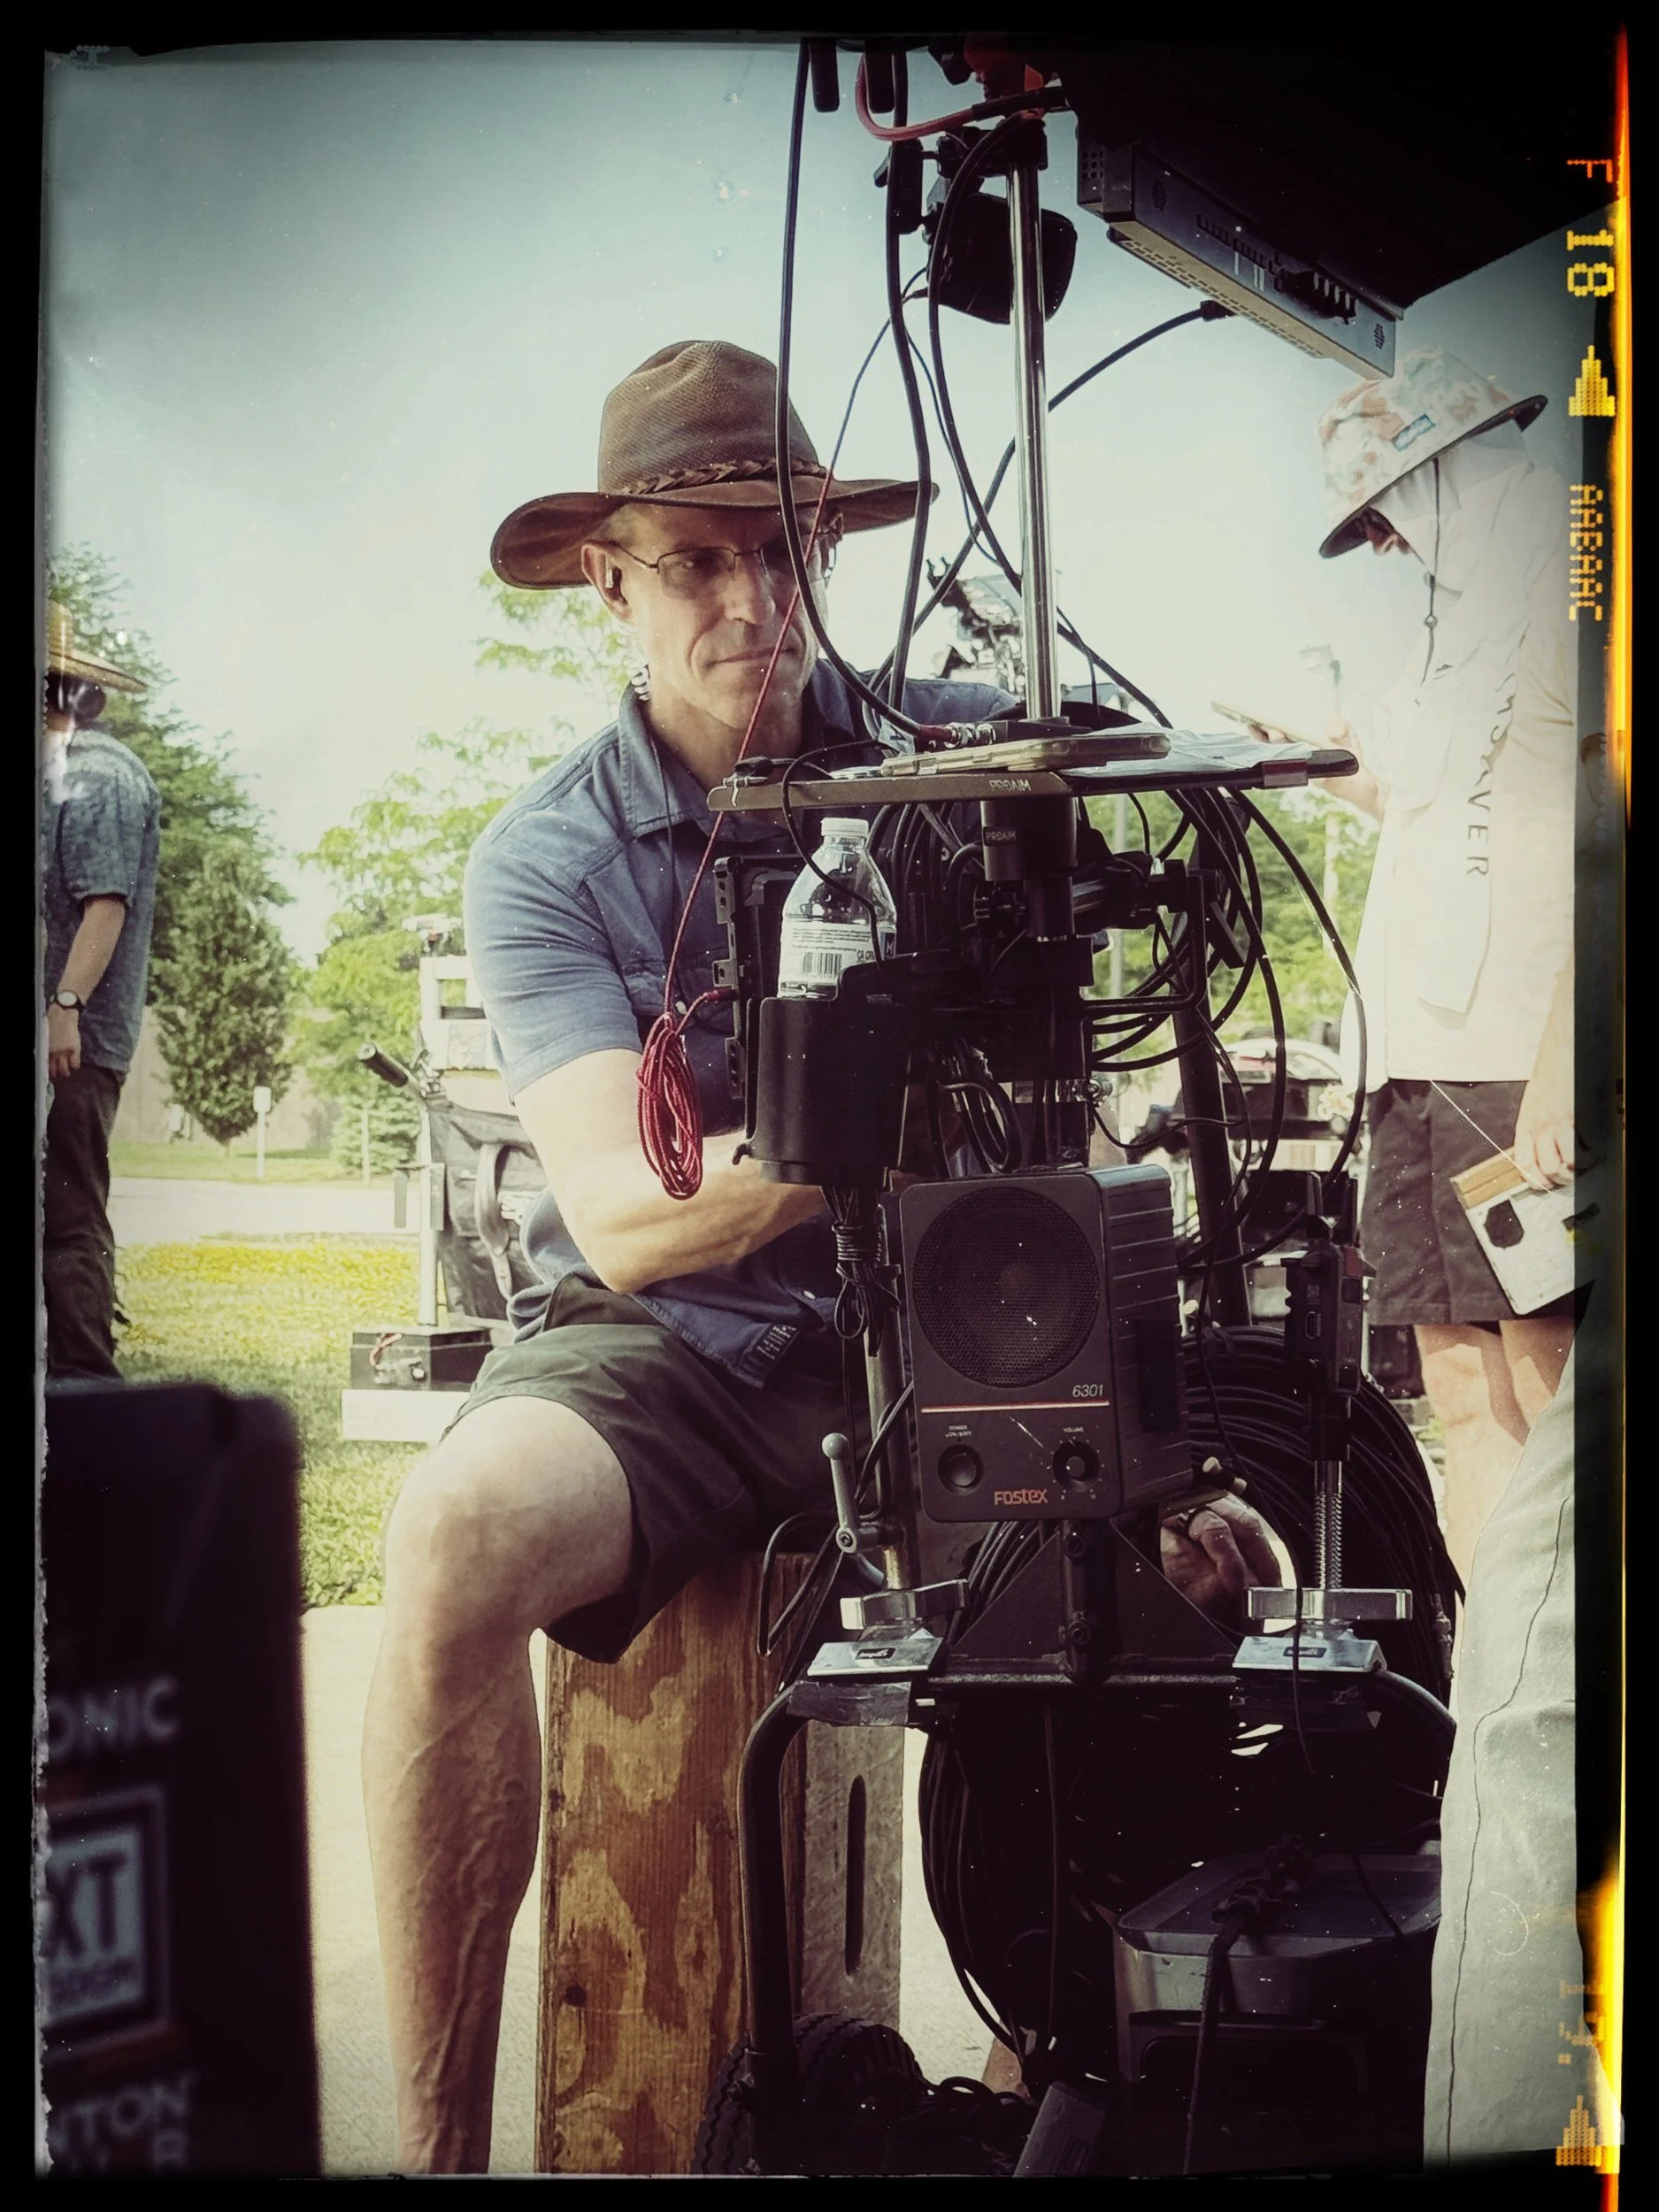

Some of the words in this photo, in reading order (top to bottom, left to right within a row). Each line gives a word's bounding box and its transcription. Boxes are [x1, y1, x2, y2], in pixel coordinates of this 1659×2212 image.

[988, 779, 1032, 792] PROAIM
[986, 831, 1017, 841] PROAIM
[1072, 1385, 1104, 1398] 6301
